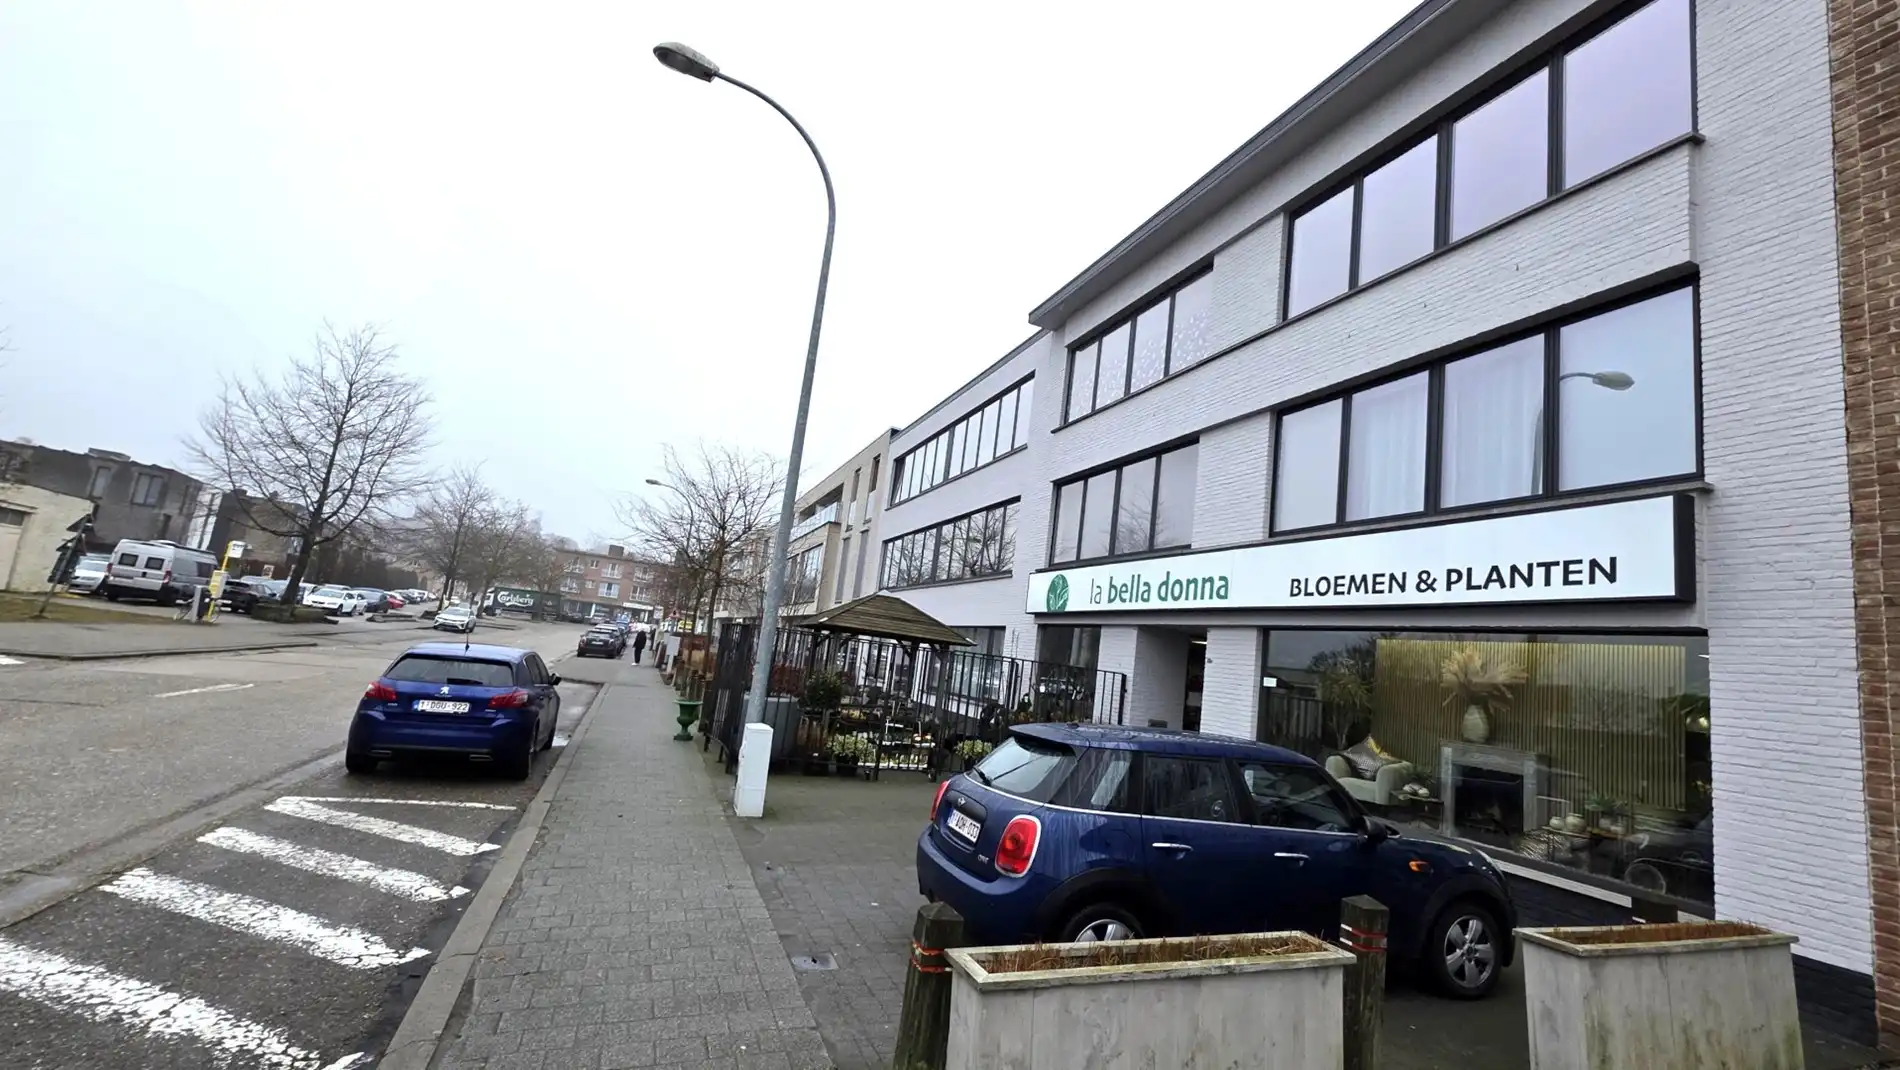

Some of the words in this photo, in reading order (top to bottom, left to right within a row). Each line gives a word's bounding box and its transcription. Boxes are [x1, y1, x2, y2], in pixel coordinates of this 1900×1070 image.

[1089, 577, 1102, 605] la
[1107, 573, 1151, 604] bella
[1157, 570, 1229, 602] donna
[1289, 571, 1407, 598] BLOEMEN
[1415, 569, 1438, 593] &
[1445, 556, 1618, 592] PLANTEN
[497, 591, 534, 607] Carlsberg
